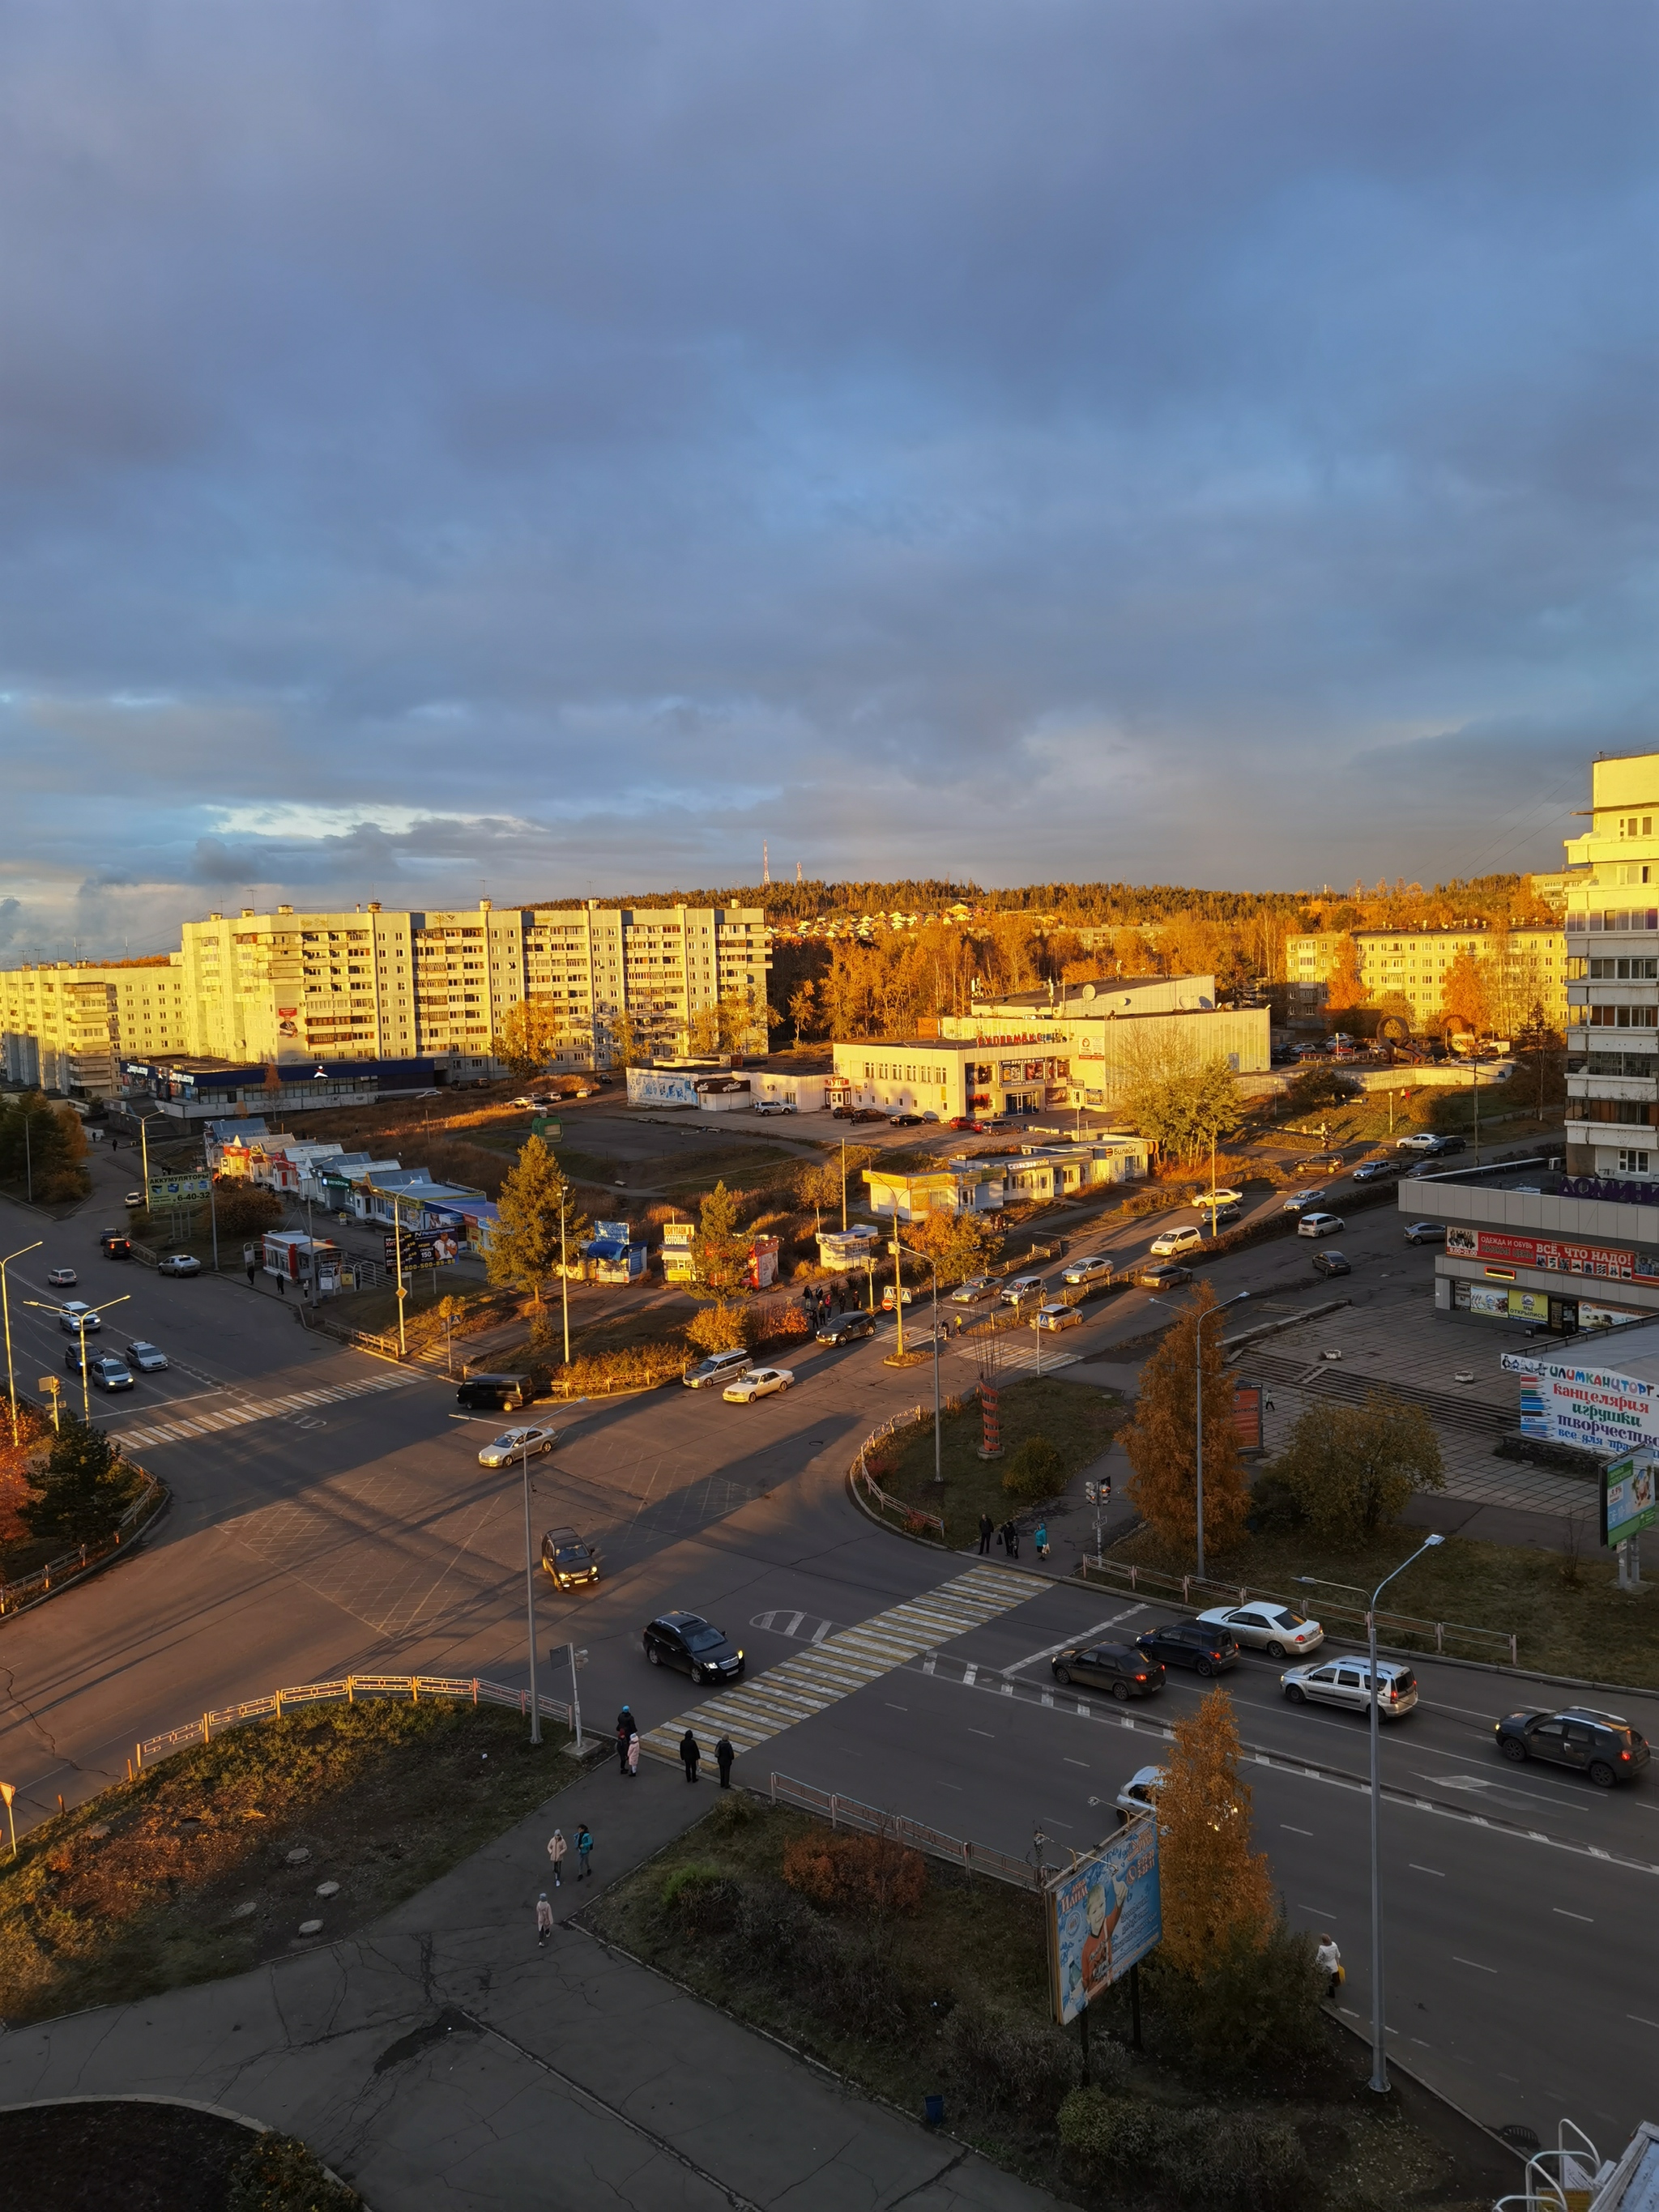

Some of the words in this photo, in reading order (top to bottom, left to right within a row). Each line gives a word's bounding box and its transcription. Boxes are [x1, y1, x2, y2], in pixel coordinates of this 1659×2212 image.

[150, 1173, 209, 1184] АККУМУЛЯТОРЫ
[177, 1191, 211, 1201] 6-40-32
[1481, 1235, 1507, 1247] ОДЕЖДА
[1513, 1241, 1533, 1250] ОБУВЬ
[1536, 1242, 1561, 1257] ВСЁ,
[1564, 1247, 1588, 1259] ЧТО
[1591, 1251, 1631, 1266] НАДО!
[1510, 1308, 1547, 1319] ОТКРЫЛИСЬ!
[1550, 1366, 1655, 1397] ИЛИМКАНЦТОРГ
[1553, 1383, 1649, 1414] канцелярия
[1572, 1403, 1643, 1427] игрушки
[1559, 1429, 1577, 1439] все
[1581, 1434, 1603, 1446] для
[1094, 1517, 1107, 1528] СТОП
